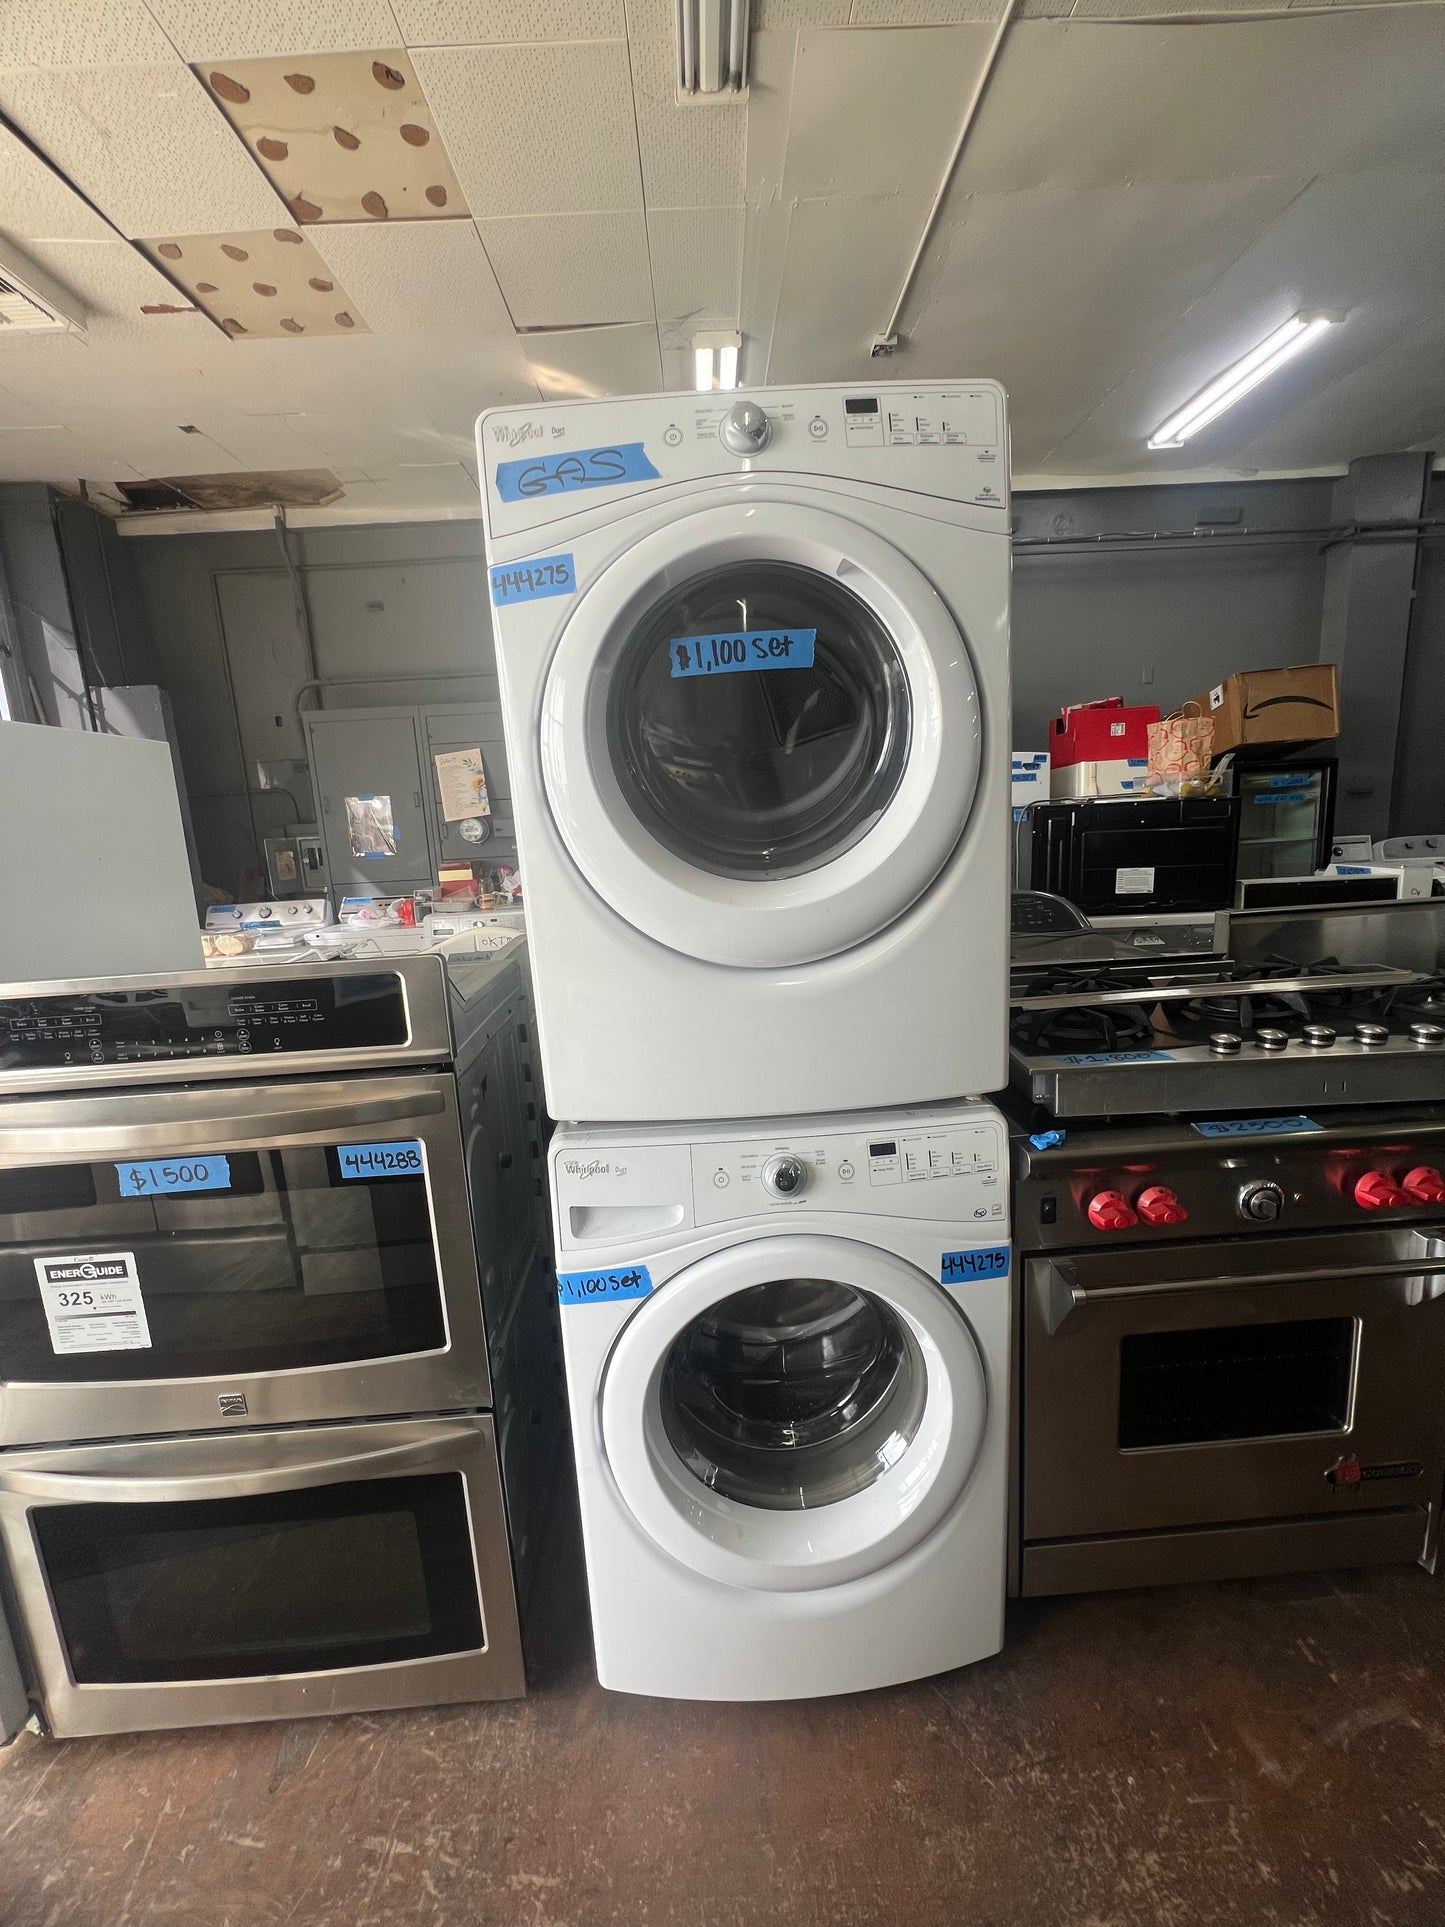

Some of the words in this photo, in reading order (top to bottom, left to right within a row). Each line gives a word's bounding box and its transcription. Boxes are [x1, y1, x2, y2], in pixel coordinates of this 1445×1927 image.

[518, 449, 627, 496] GAS
[492, 564, 570, 597] 444275
[677, 639, 746, 672] $1,100
[1208, 1120, 1303, 1133] $2500
[345, 1149, 422, 1174] 444288
[563, 1159, 610, 1180] Whirlpool
[130, 1163, 209, 1191] $1500
[49, 1263, 124, 1280] ENERGUIDE
[941, 1252, 1006, 1276] 444275
[58, 1291, 94, 1307] 325
[100, 1293, 117, 1301] kWh
